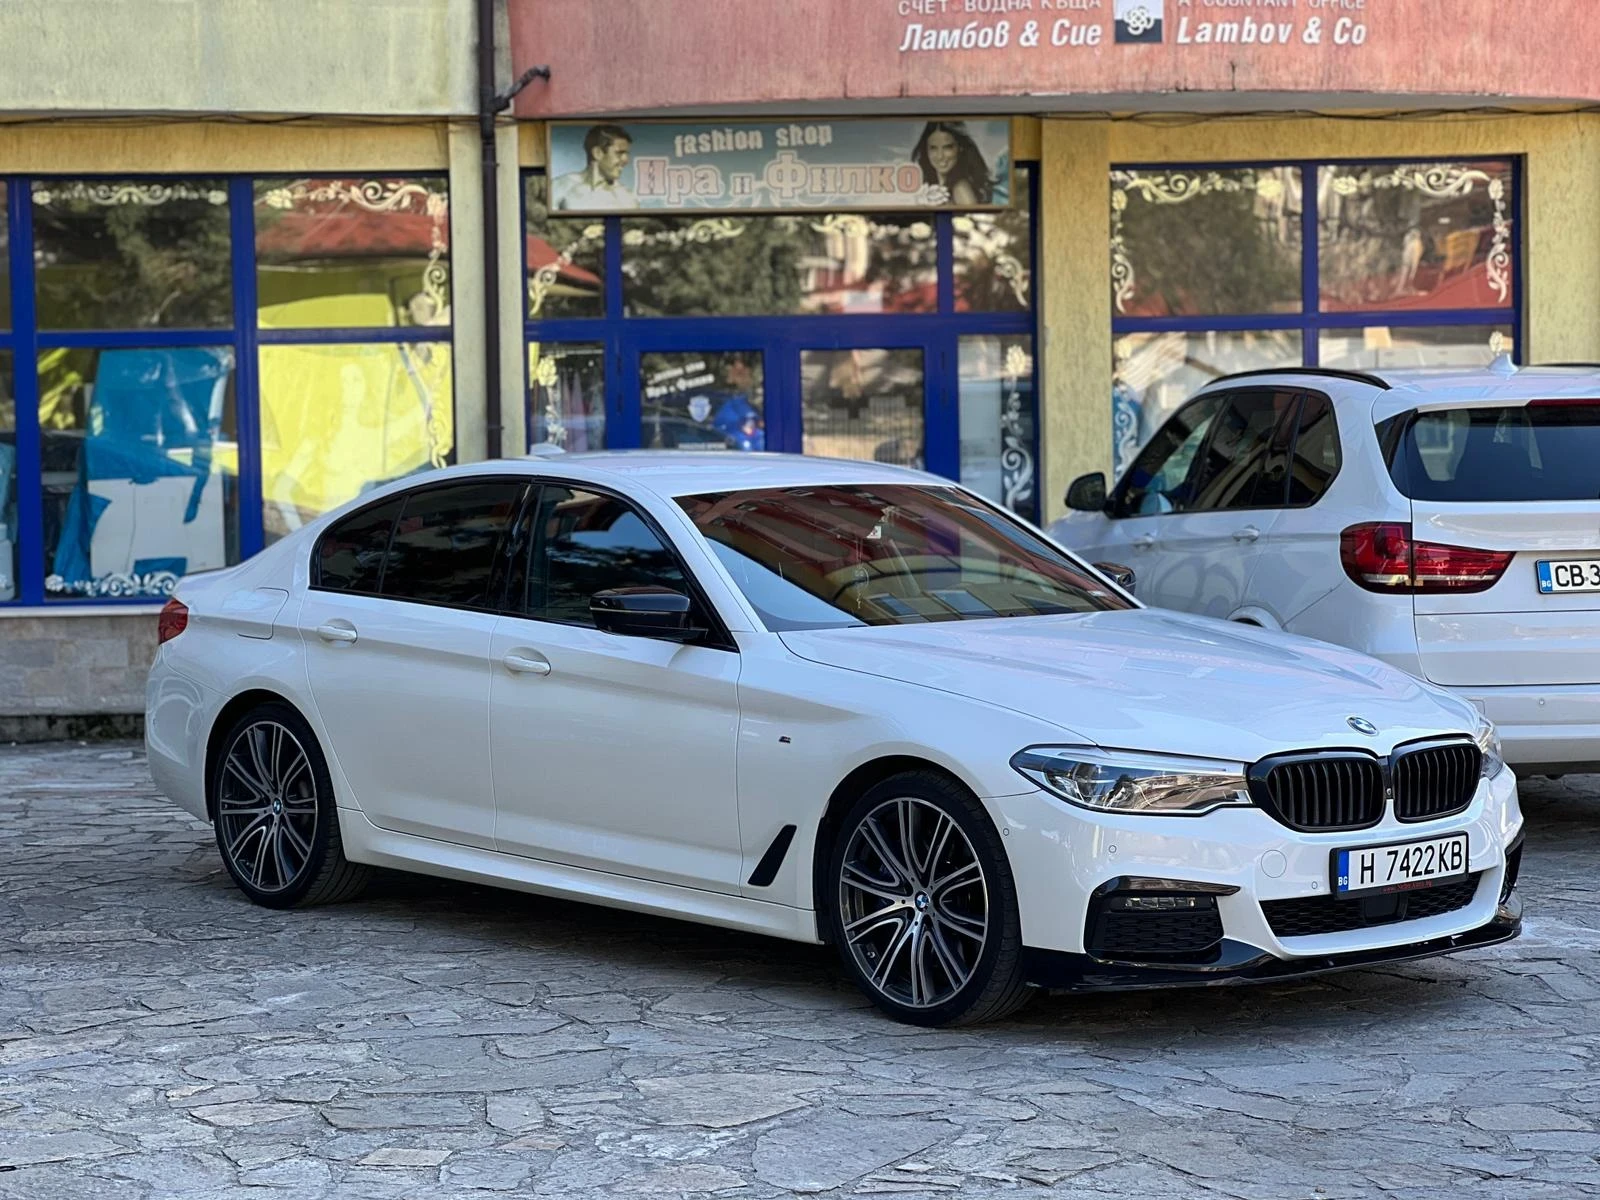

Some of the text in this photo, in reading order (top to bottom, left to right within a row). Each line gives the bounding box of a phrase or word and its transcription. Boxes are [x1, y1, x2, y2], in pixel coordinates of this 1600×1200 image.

[899, 18, 1102, 51] Ламбов & Сие
[1176, 16, 1367, 44] Lambov & Co
[674, 124, 832, 157] fashion shop
[765, 150, 922, 199] Филко
[1338, 876, 1348, 886] BG
[1360, 853, 1375, 884] H
